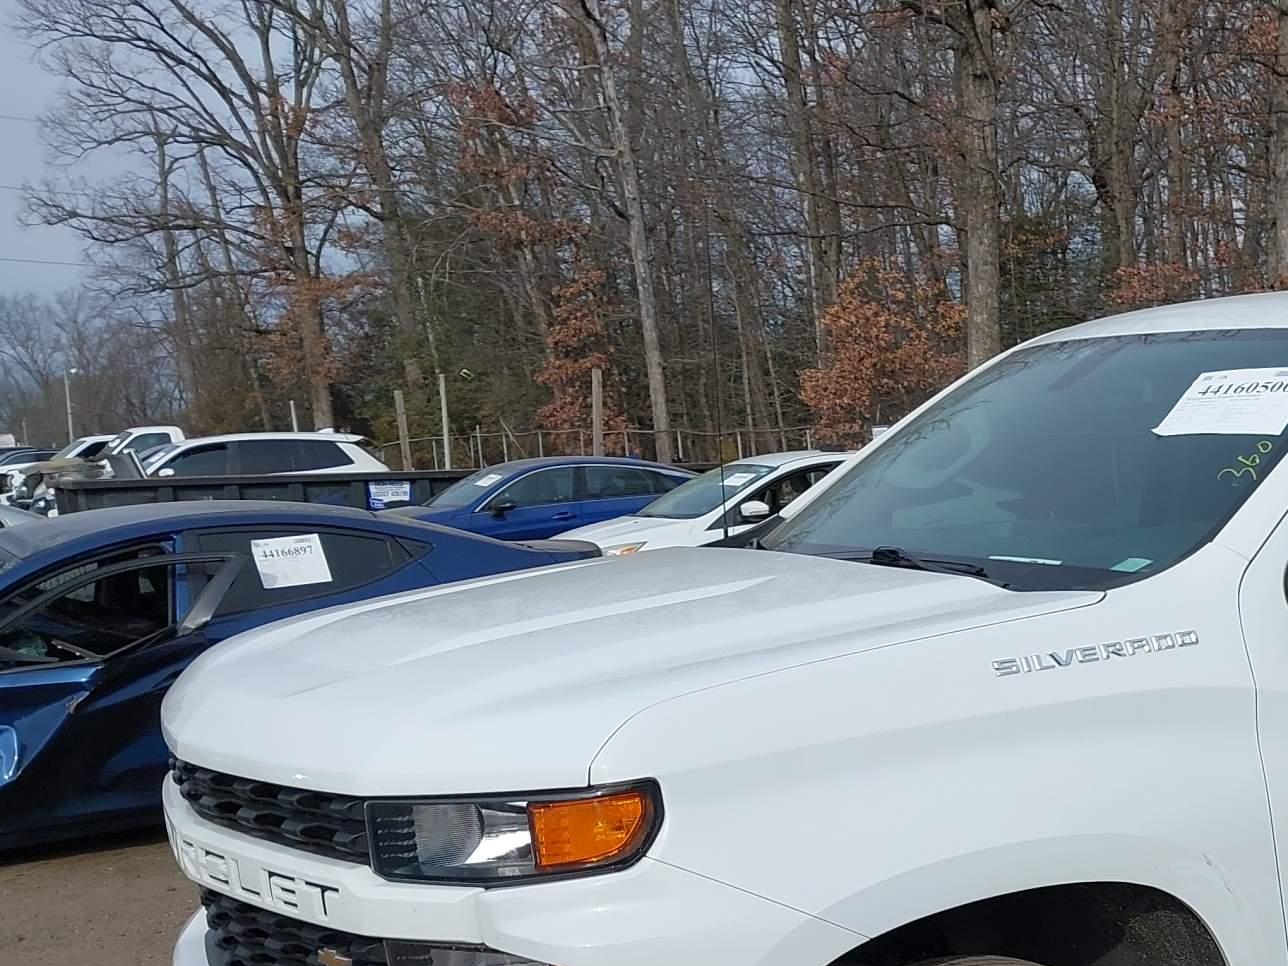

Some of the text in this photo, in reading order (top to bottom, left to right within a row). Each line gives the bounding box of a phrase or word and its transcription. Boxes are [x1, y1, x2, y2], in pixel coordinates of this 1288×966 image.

[1216, 439, 1273, 481] 360
[261, 544, 313, 560] 44166897
[991, 629, 1199, 677] SILVERADO
